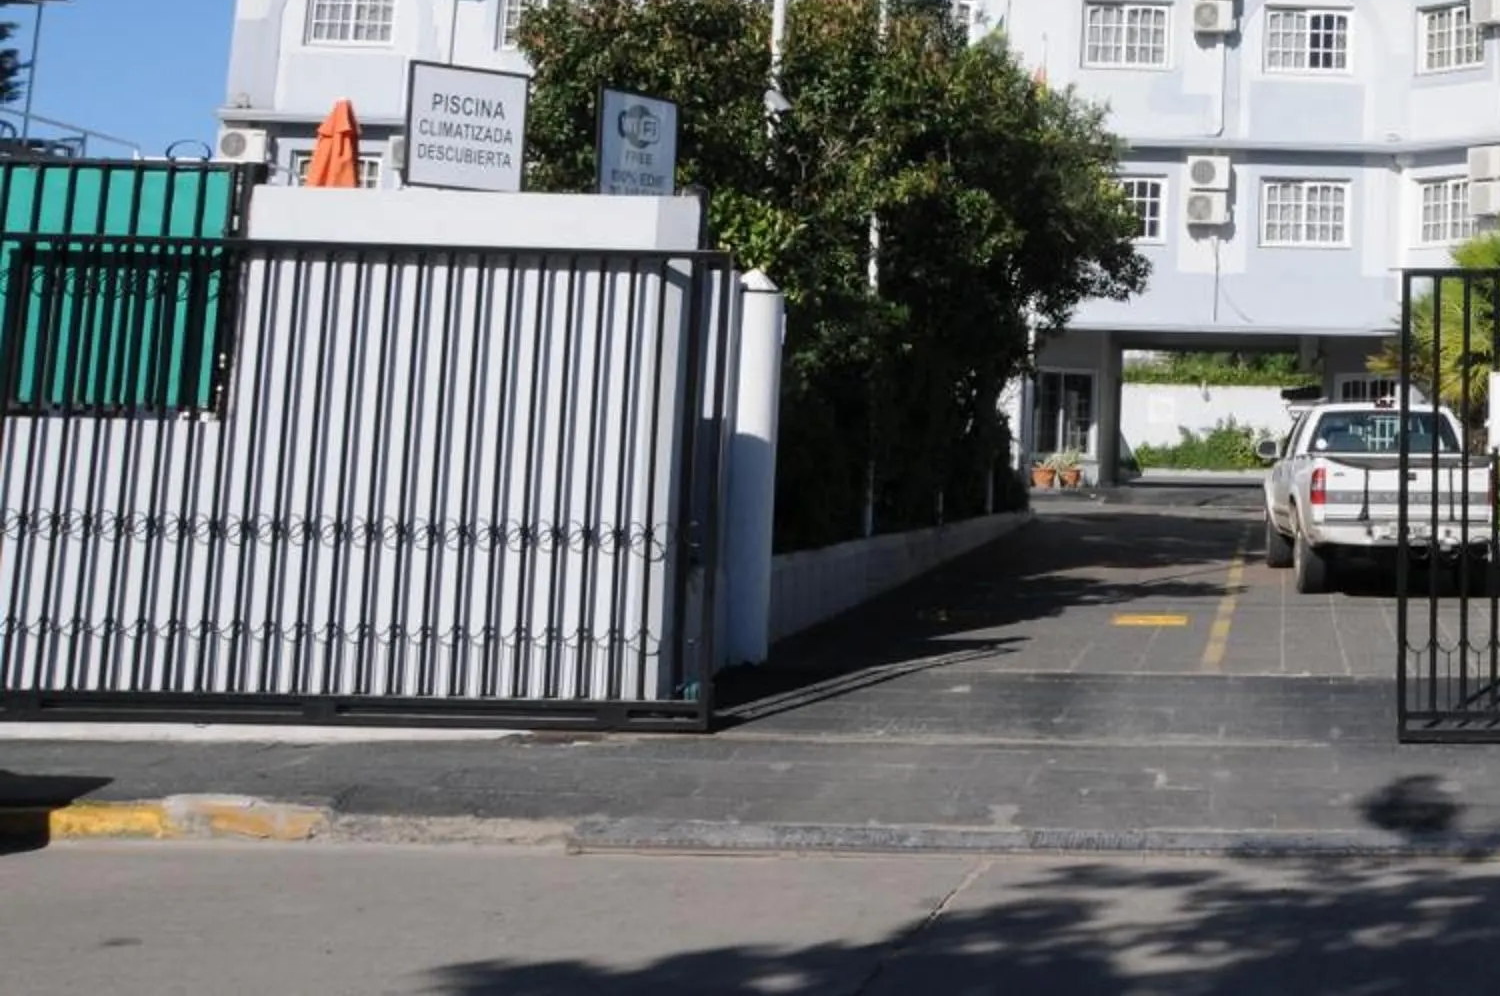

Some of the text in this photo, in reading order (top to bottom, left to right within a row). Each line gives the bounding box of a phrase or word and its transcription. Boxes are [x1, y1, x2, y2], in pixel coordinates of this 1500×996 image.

[432, 92, 506, 120] PISCINA
[418, 118, 514, 145] CLIMATIZADA
[416, 142, 512, 169] DESCUBIERTA
